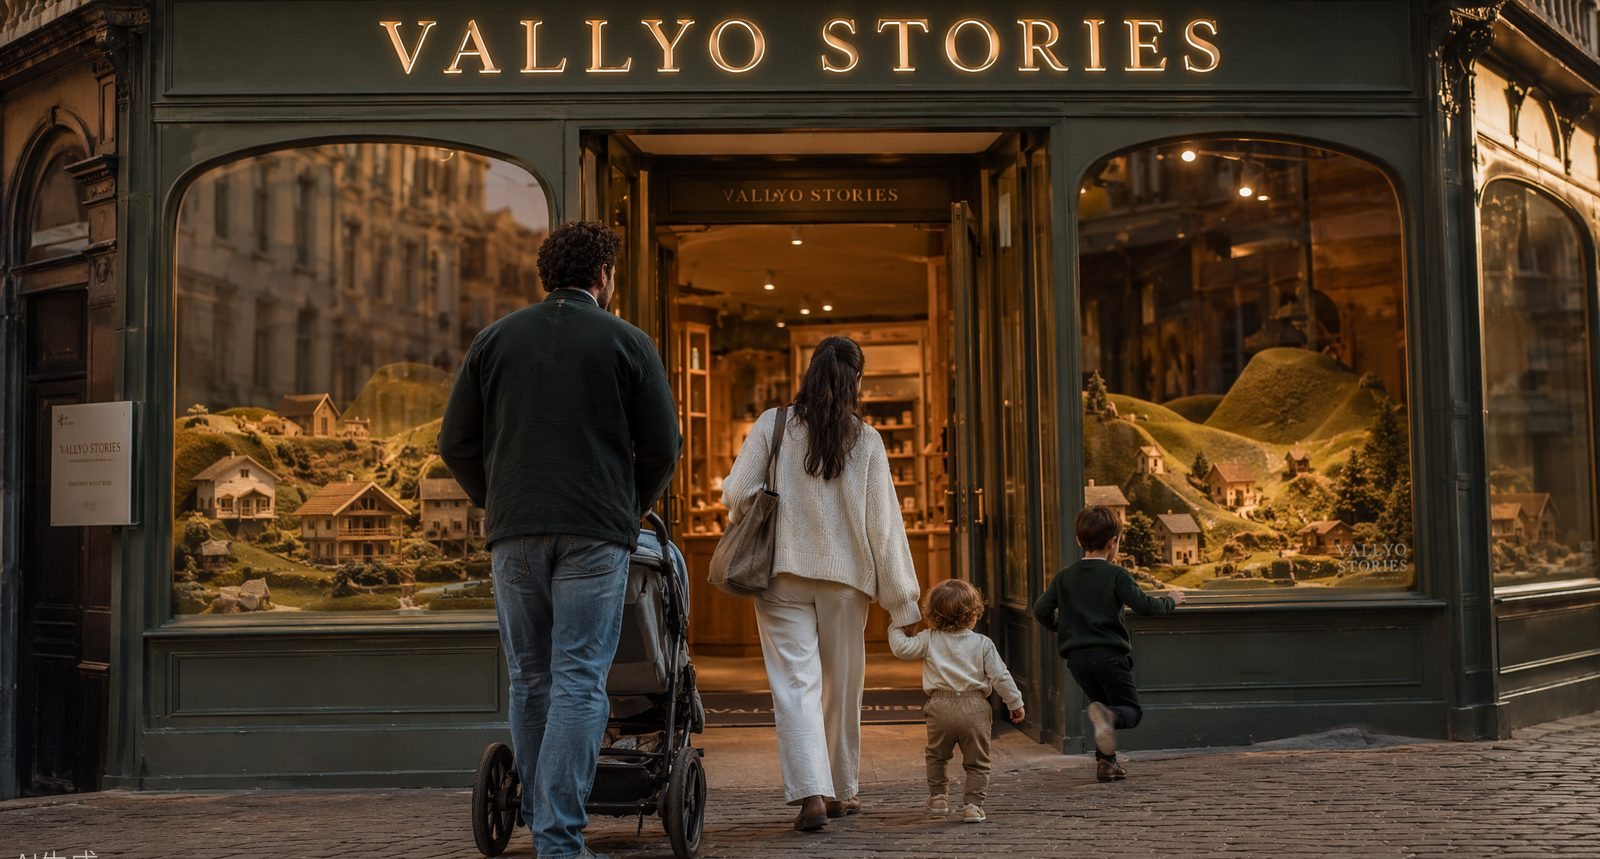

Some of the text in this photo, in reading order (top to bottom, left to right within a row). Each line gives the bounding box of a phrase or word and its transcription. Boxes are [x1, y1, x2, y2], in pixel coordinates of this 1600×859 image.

[378, 17, 1222, 75] VALLYO STORIES
[723, 187, 899, 203] VALLYO STORIES
[60, 441, 121, 455] VALLYO STORIES
[1336, 543, 1407, 558] VALLYO
[1337, 559, 1409, 574] STORIES
